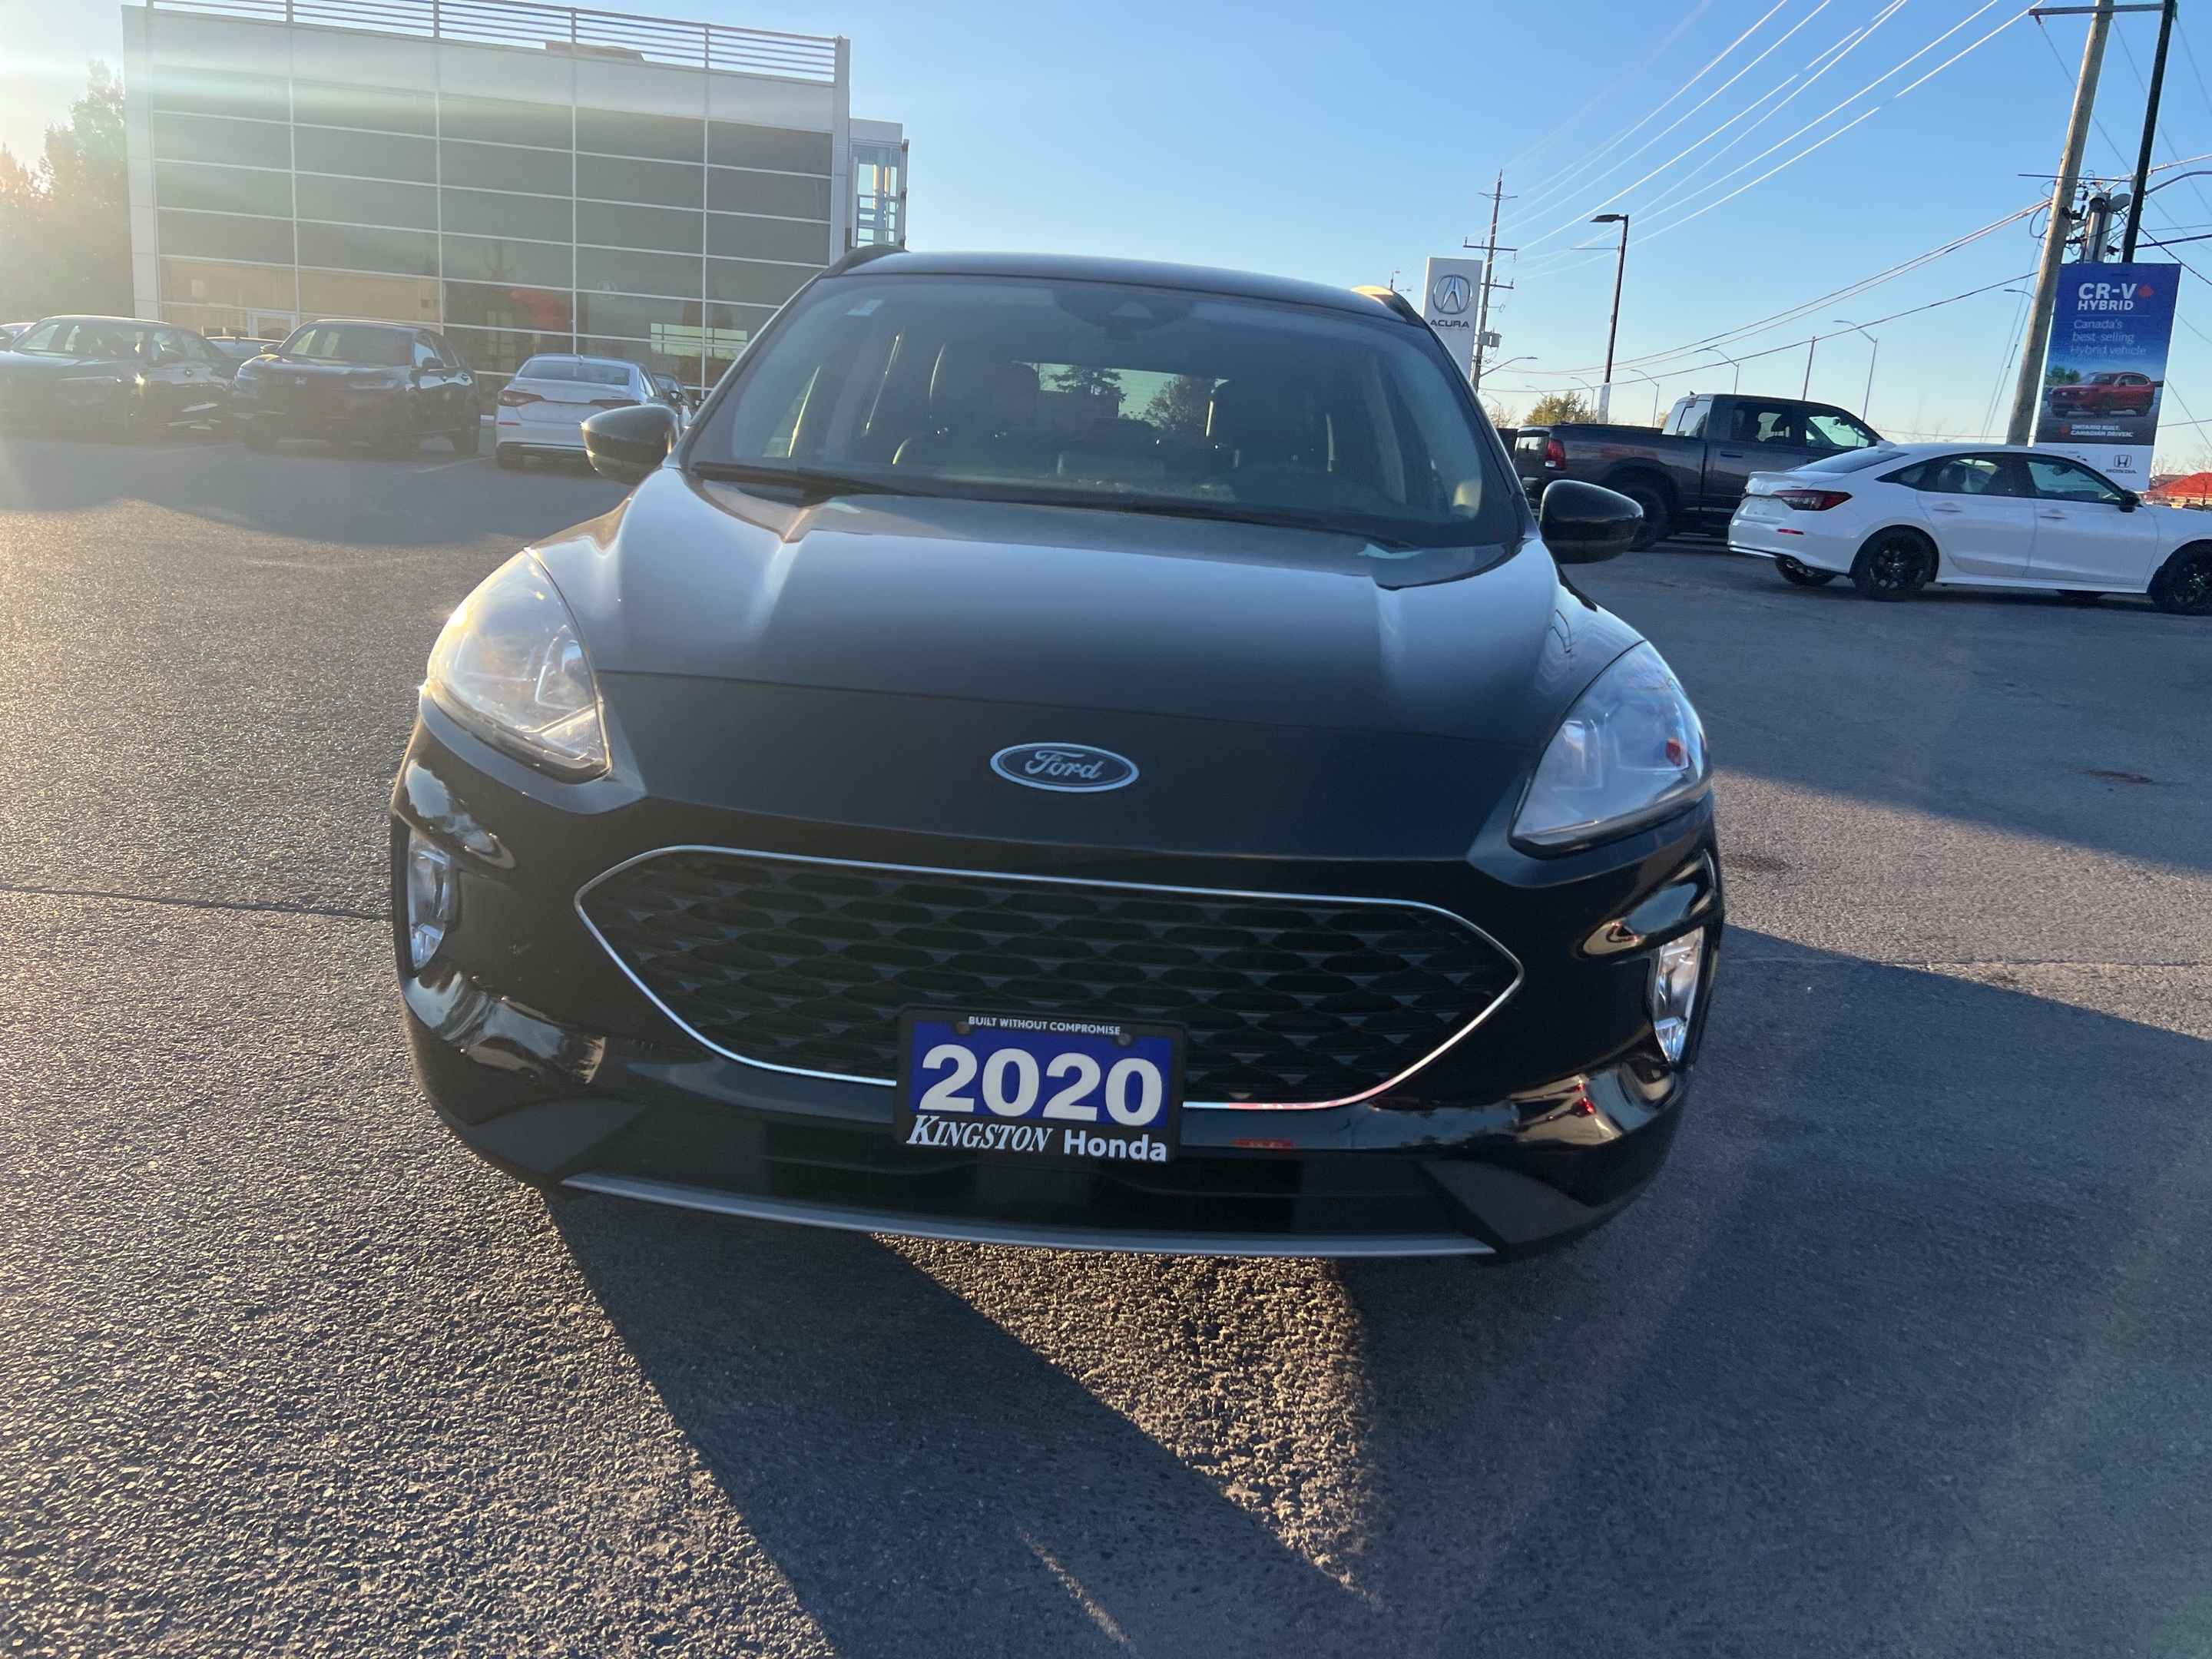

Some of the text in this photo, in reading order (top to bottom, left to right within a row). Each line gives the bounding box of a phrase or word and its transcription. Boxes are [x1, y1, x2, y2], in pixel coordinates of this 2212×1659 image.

[2078, 283, 2137, 300] CR-V
[2078, 300, 2134, 310] HYBRID
[1430, 320, 1469, 328] ACURA
[2074, 319, 2122, 329] Canada's
[2071, 345, 2147, 356] Hybrid vehicle
[1025, 750, 1104, 779] Ford
[969, 1016, 1121, 1035] BUILT WITHOUT COMPROMISE
[919, 1044, 1163, 1126] 2020
[906, 1114, 1167, 1162] KINGSTON Honda
